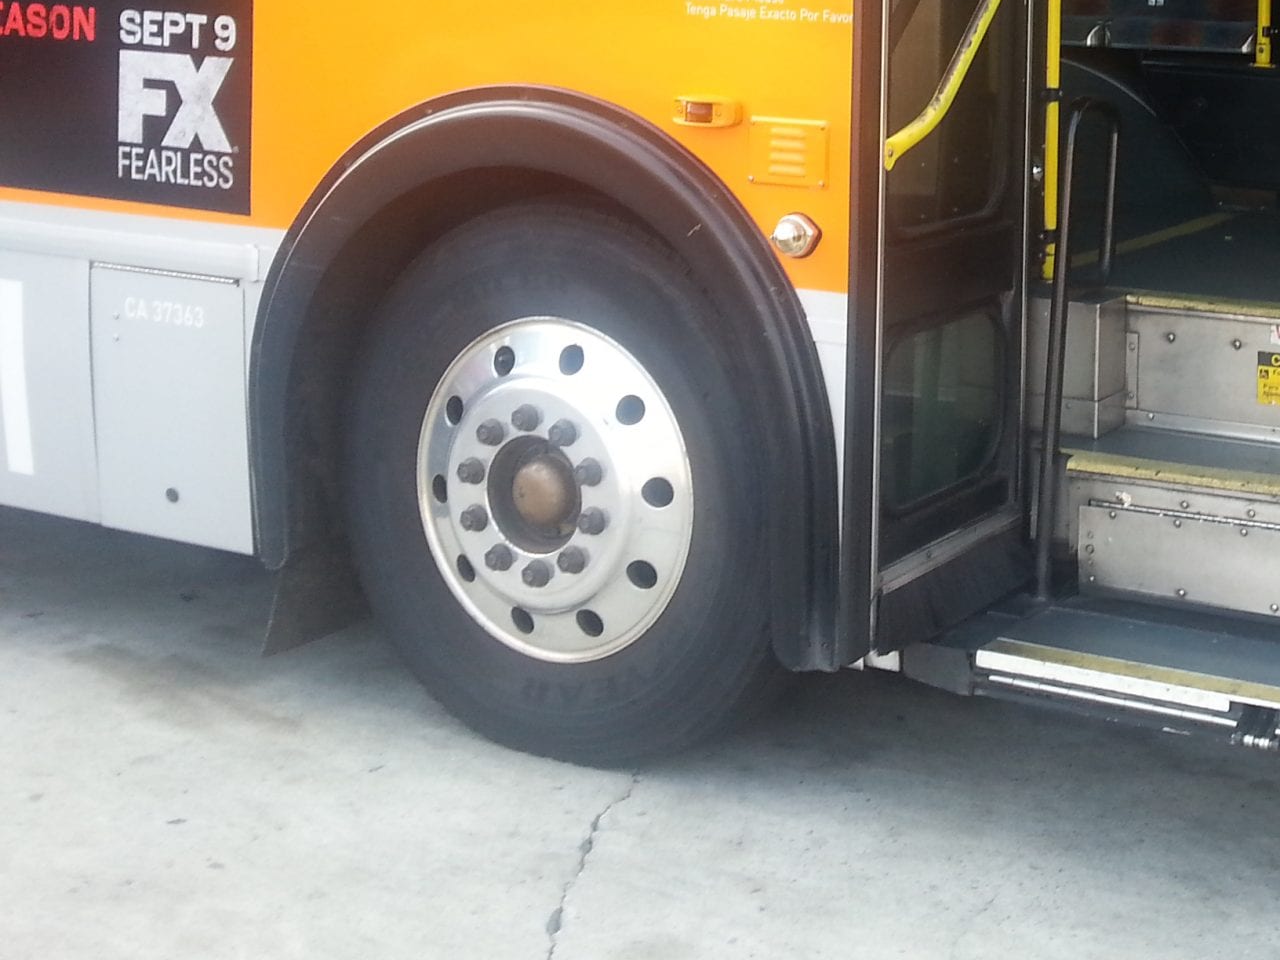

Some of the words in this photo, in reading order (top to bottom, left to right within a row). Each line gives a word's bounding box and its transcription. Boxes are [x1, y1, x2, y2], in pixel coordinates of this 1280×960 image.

[0, 1, 97, 43] ASON
[119, 9, 207, 50] SEPT
[213, 14, 237, 52] 9
[686, 2, 717, 20] Tenga
[719, 4, 757, 22] Pasaje
[759, 6, 797, 21] Exacto
[799, 8, 819, 22] Por
[118, 49, 235, 154] FX
[118, 145, 234, 190] FEARLESS
[124, 296, 149, 320] CA
[153, 302, 205, 328] 37363
